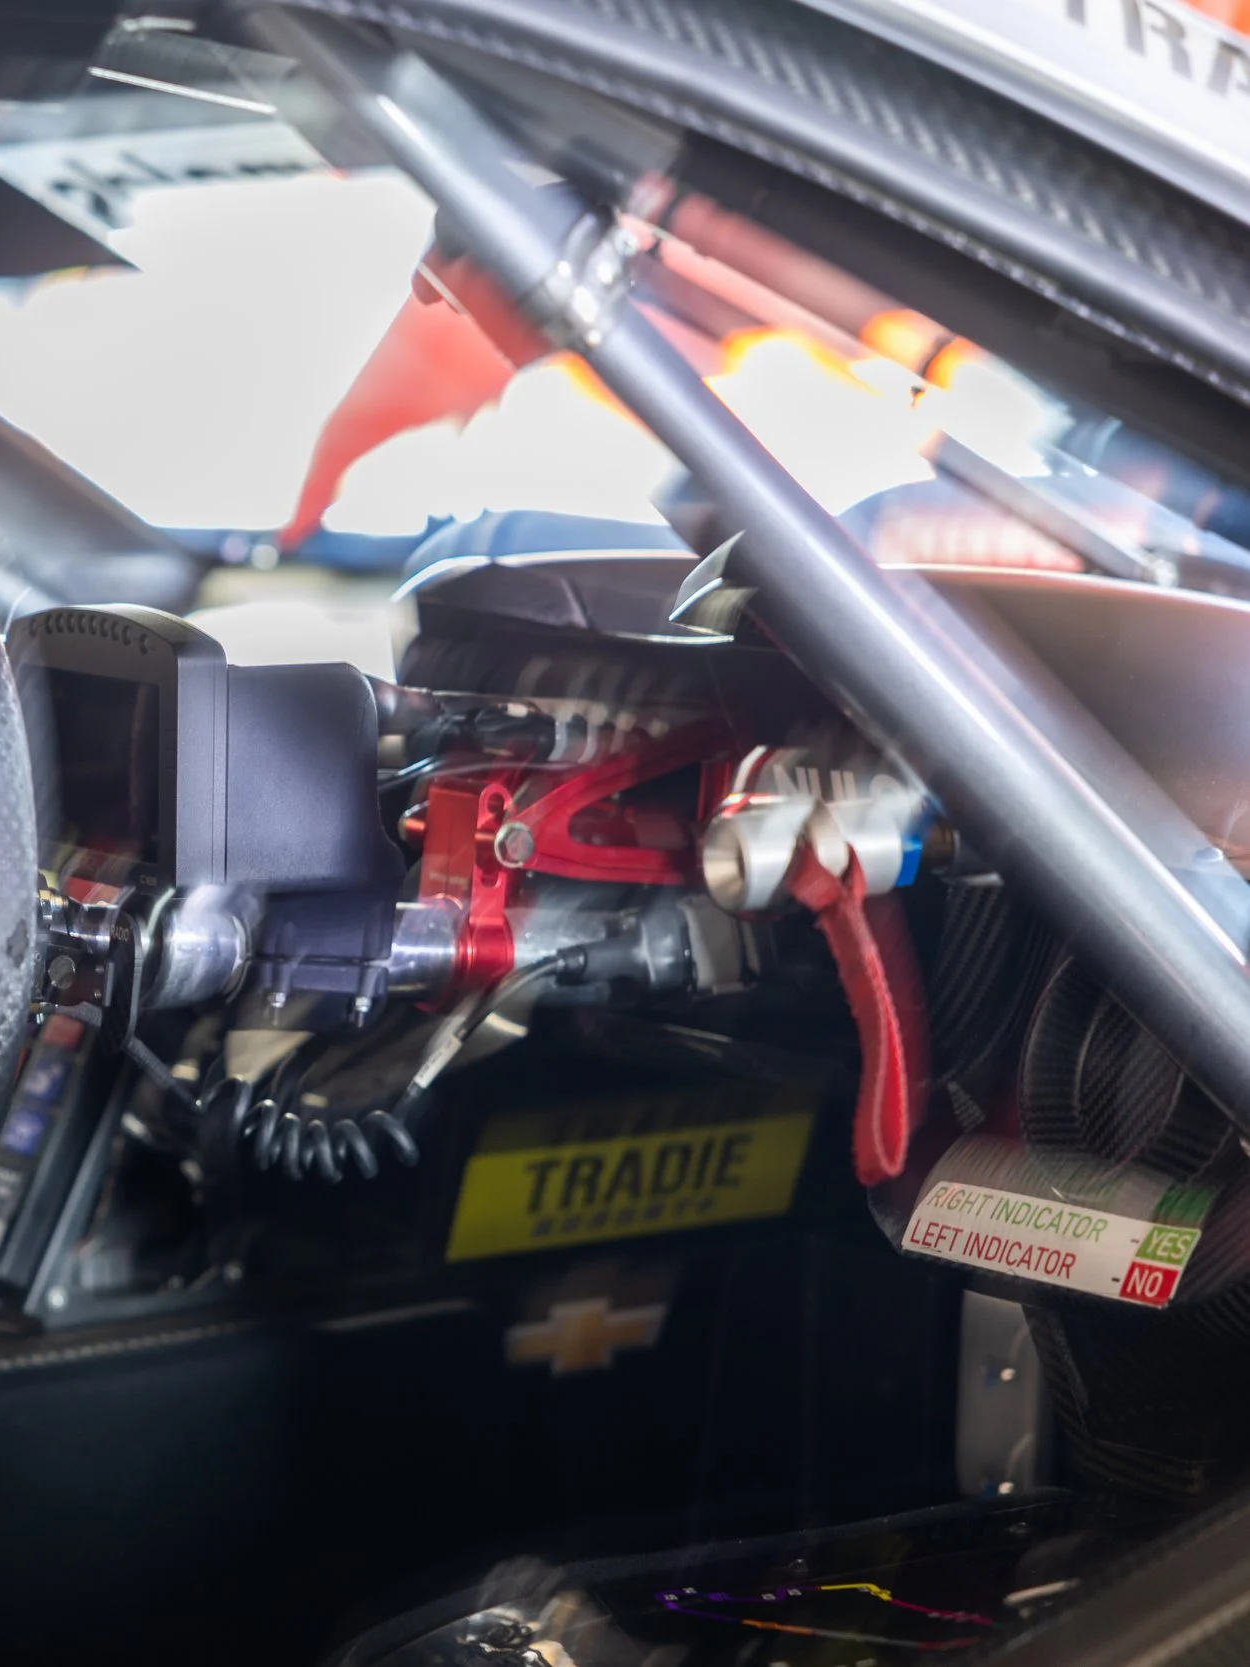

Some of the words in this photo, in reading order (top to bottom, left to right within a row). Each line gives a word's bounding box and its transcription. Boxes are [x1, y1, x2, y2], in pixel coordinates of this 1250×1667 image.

[526, 1135, 749, 1214] TRADIE
[910, 1220, 963, 1251] LEFT
[962, 1234, 1077, 1279] INDICATOR
[1127, 1265, 1162, 1298] NO
[928, 1186, 993, 1218] RIGHT
[990, 1197, 1108, 1243] INDICATOR
[1145, 1231, 1191, 1258] YES
